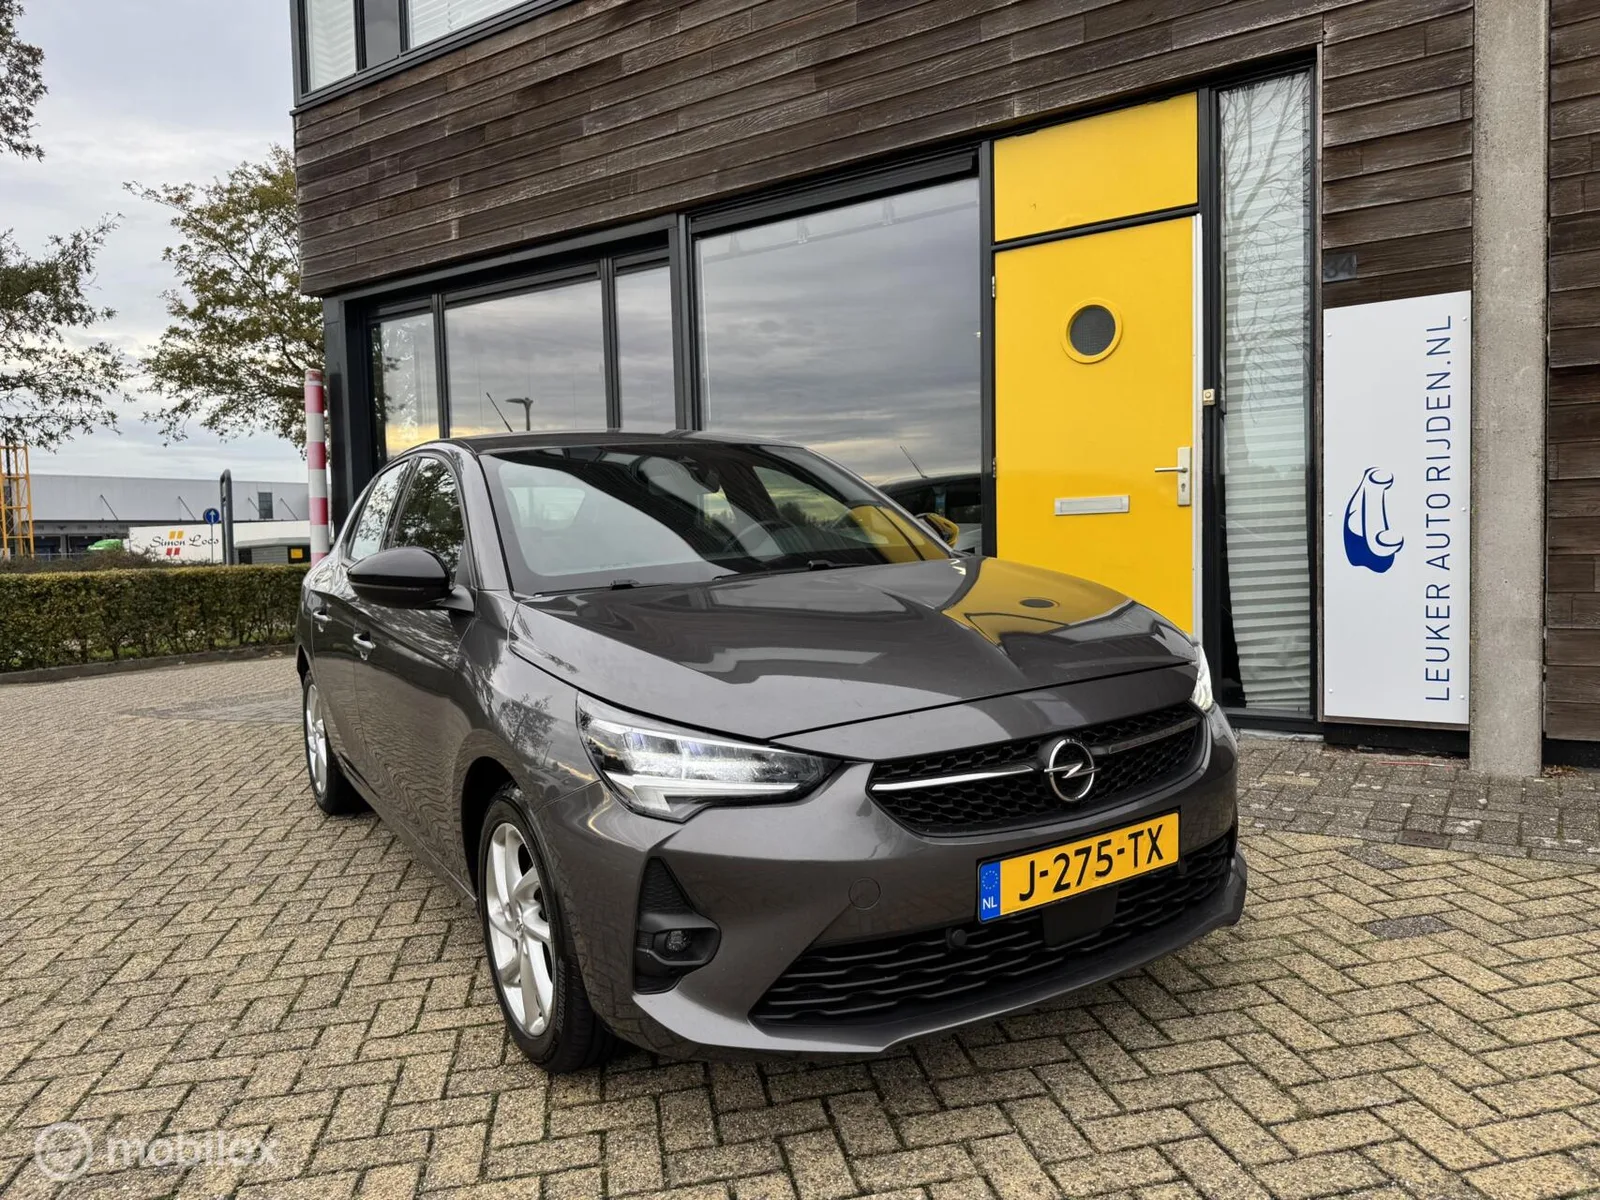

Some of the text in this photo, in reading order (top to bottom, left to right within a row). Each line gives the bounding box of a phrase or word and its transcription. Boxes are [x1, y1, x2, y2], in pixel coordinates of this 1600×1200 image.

[1425, 315, 1451, 701] LEUKER AUTO RIJDEN.NL
[150, 534, 220, 548] Simon Loos
[1018, 824, 1164, 902] J-275-TX
[982, 896, 998, 910] NL
